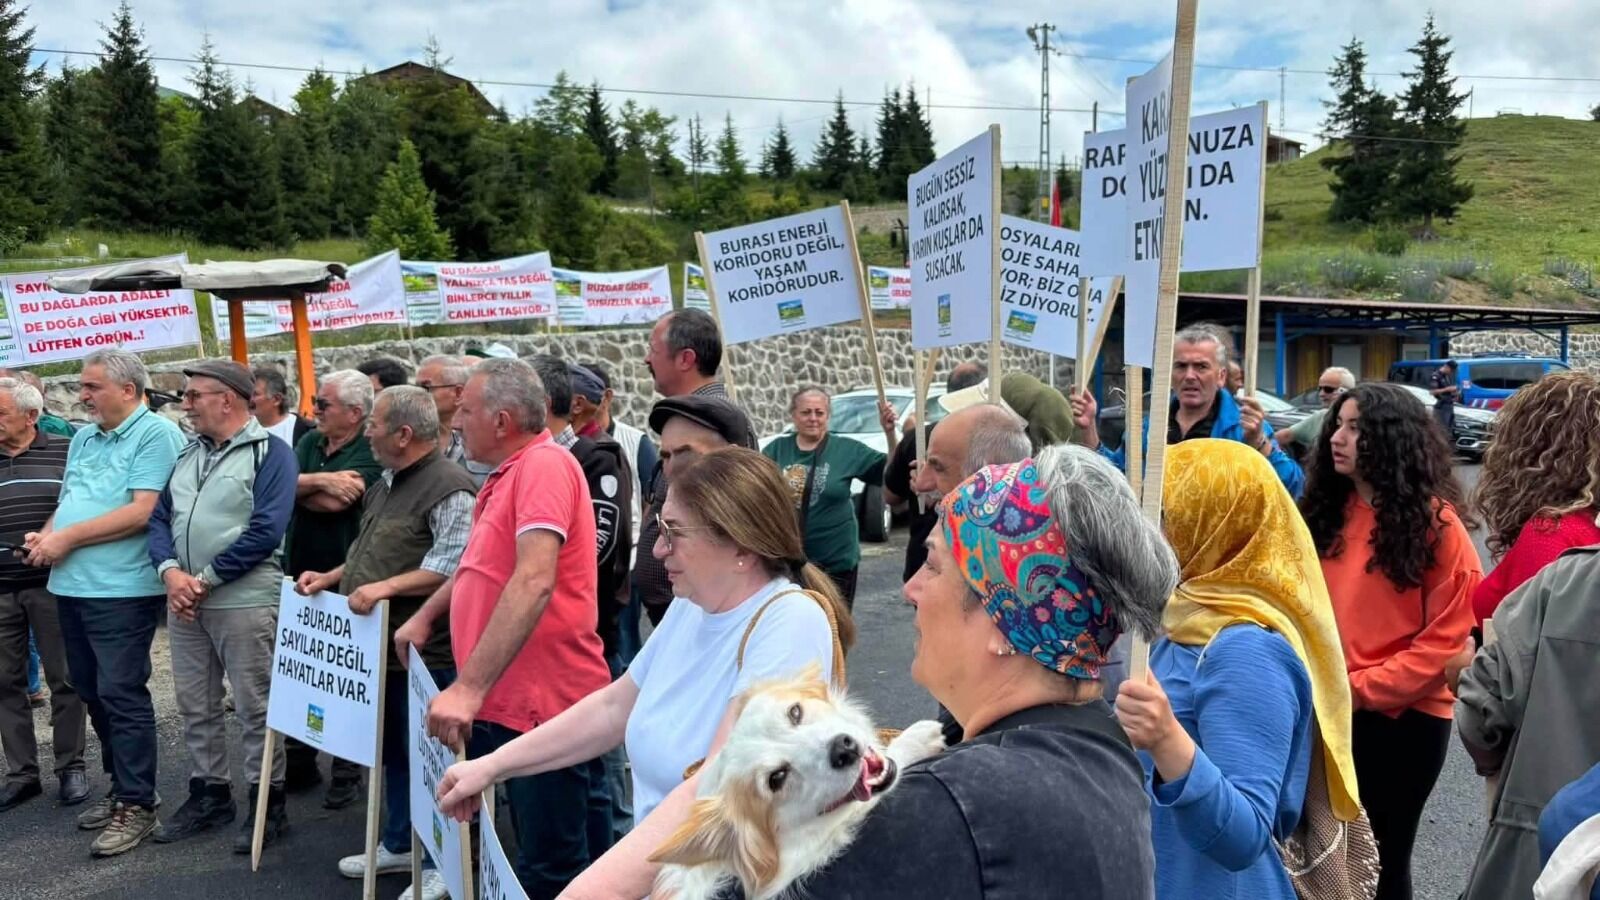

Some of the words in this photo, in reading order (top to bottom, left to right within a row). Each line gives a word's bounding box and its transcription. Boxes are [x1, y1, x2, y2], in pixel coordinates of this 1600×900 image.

[916, 173, 943, 208] BUGÜN
[944, 155, 976, 193] SESSİZ
[1200, 161, 1234, 188] DA
[923, 191, 967, 231] KALIRSAK,
[720, 231, 775, 255] BURASI
[778, 218, 829, 243] ENERJİ
[912, 235, 933, 261] YARIN
[933, 220, 967, 255] KUŞLAR
[968, 214, 984, 241] DA
[713, 248, 793, 274] KORİDORU
[796, 236, 846, 258] DEĞİL,
[925, 251, 966, 283] SUSACAK.
[1000, 247, 1032, 267] OJE
[1034, 255, 1080, 278] SAHA
[728, 269, 844, 304] KORİDORUDUR.
[754, 259, 808, 283] YAŞAM
[20, 302, 39, 314] BU
[43, 294, 117, 312] DAĞLARDA
[120, 288, 171, 302] ADALET
[327, 281, 351, 293] NDA
[446, 291, 497, 303] BİNLERCE
[500, 290, 532, 301] YILLIK
[1000, 285, 1017, 304] İZ
[1037, 276, 1065, 295] BİZ
[1067, 284, 1102, 304] OA
[24, 321, 44, 334] DE
[46, 316, 88, 332] DOĞA
[90, 312, 117, 327] GİBİ
[119, 303, 194, 322] YÜKSEKTİR.
[448, 308, 497, 320] CANLILIK
[28, 336, 82, 353] LÜTFEN
[296, 606, 352, 640] +BURADA
[281, 628, 325, 661] SAYILAR
[326, 643, 372, 679] DEĞİL,
[278, 655, 334, 696] HAYATLAR
[337, 675, 371, 705] VAR.
